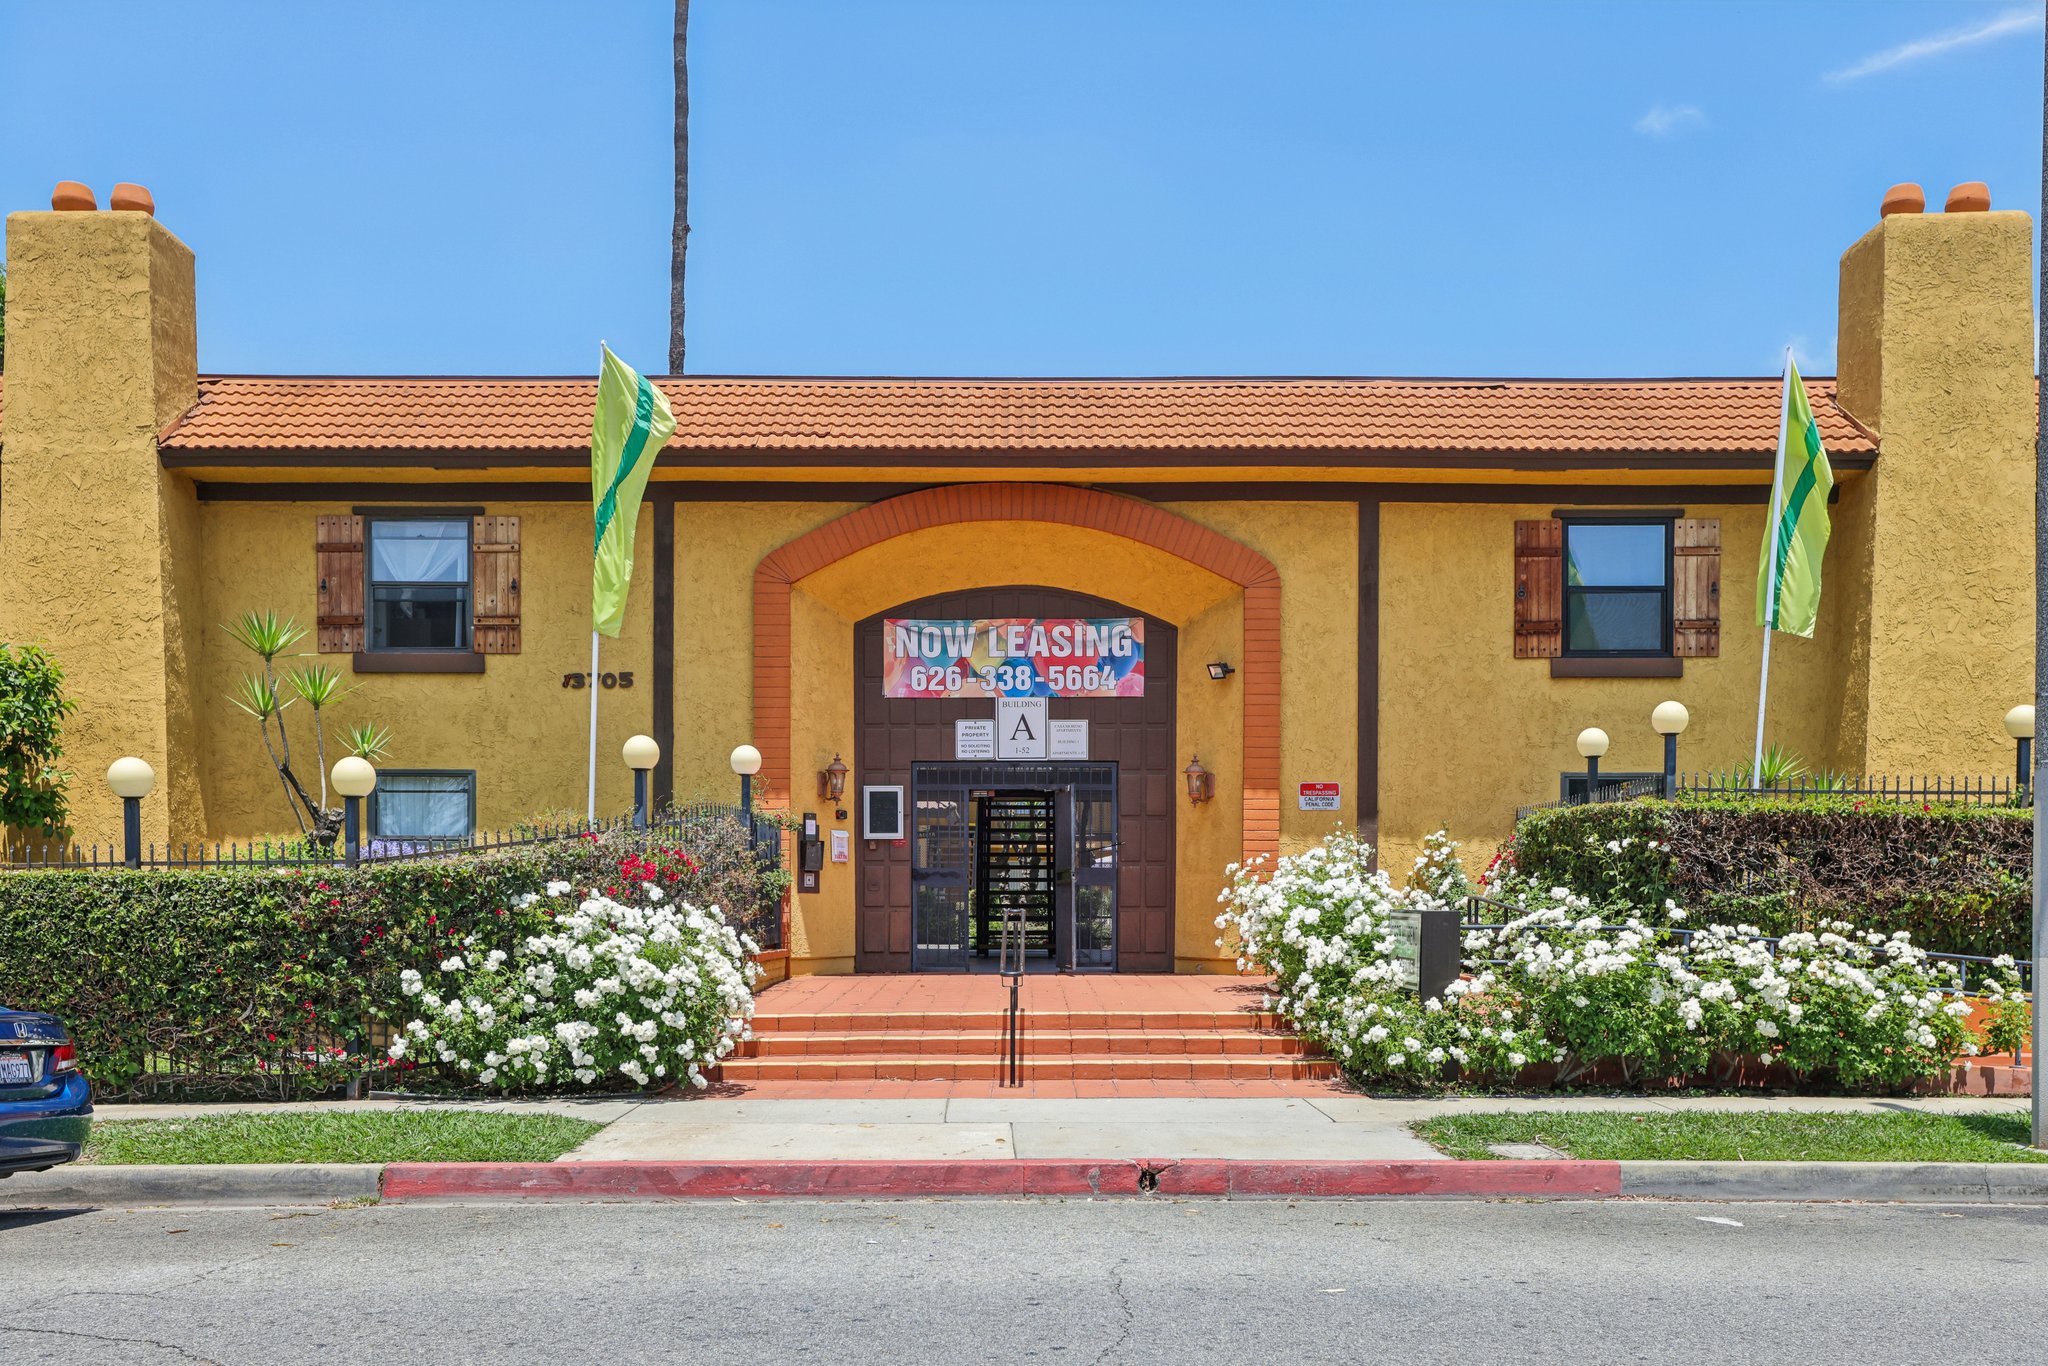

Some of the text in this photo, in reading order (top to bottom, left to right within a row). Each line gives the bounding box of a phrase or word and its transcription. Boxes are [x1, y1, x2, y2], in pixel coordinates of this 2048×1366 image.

[895, 624, 1133, 658] NOW LEASING
[910, 665, 1117, 691] 626-338-5664
[1009, 712, 1037, 741] A
